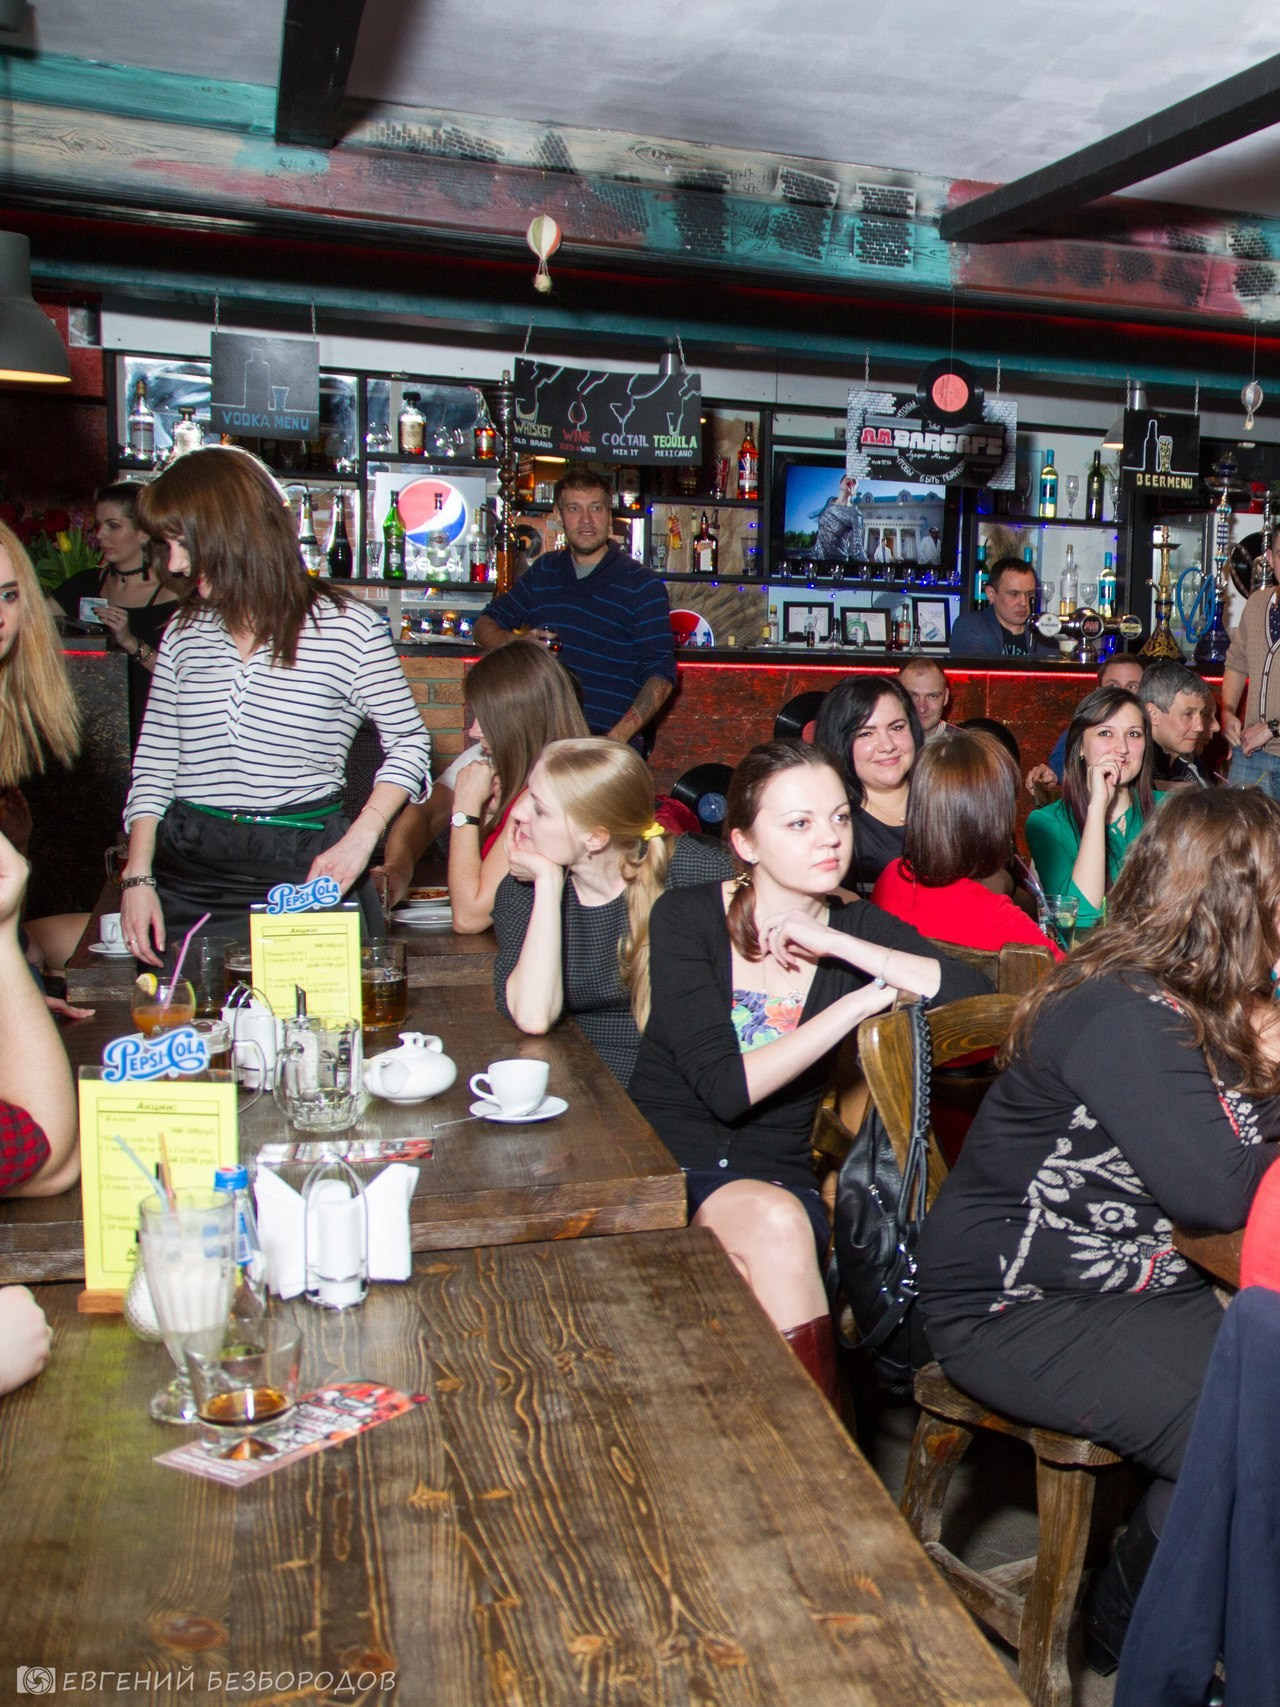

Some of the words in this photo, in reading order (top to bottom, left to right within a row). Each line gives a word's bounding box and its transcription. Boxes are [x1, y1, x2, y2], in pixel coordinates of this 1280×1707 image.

[222, 410, 271, 427] VODKA
[274, 415, 310, 431] MENU
[513, 420, 552, 438] WHISKEY
[562, 428, 591, 443] WINE
[513, 436, 527, 444] OLD
[530, 438, 553, 448] BRAND
[602, 432, 649, 447] COCTAIL
[653, 434, 698, 448] TEQUILA
[613, 448, 628, 456] MIX
[655, 449, 693, 457] MEXICANO
